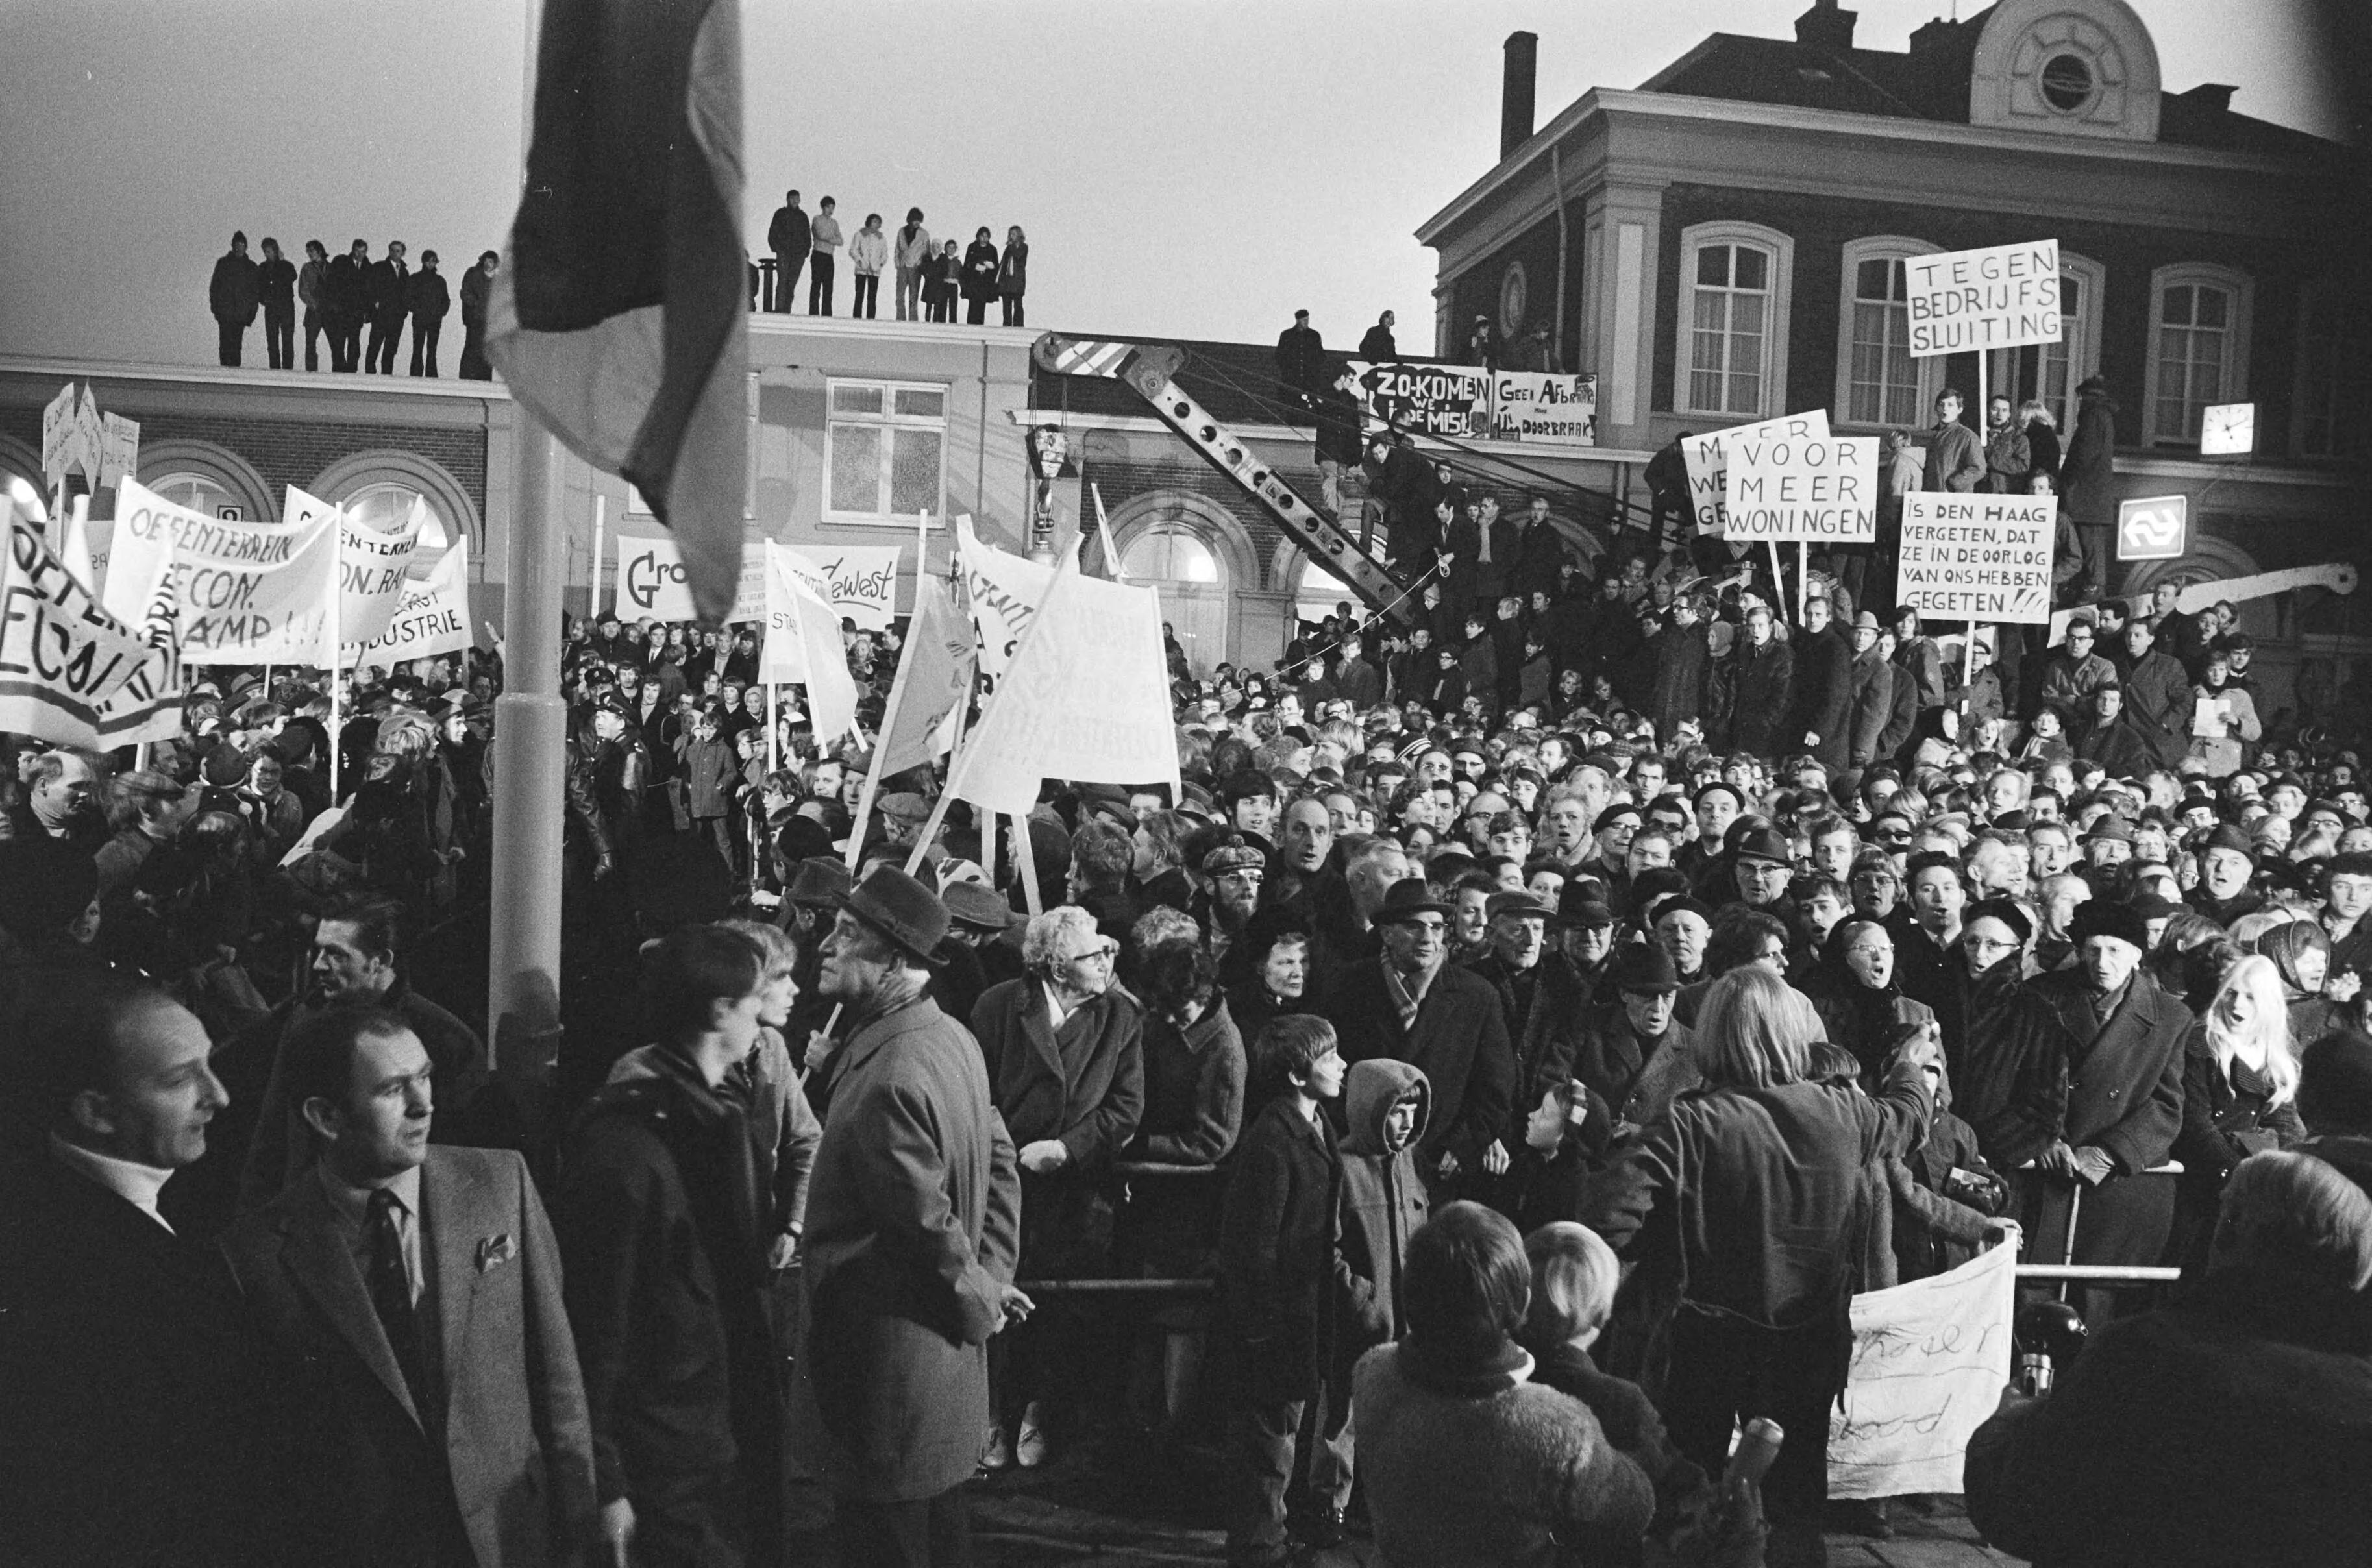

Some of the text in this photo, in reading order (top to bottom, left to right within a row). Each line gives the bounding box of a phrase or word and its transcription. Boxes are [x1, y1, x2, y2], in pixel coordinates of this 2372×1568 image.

[1915, 247, 2054, 287] TEGEN
[1911, 278, 2057, 321] BEDRIJFS
[1914, 311, 2058, 350] SLUITING
[1411, 396, 1435, 410] WE
[1743, 443, 1857, 466] VOOR
[1690, 469, 1727, 494] WE
[1740, 476, 1858, 502] MEER
[1698, 502, 1726, 526] GE
[1725, 508, 1873, 534] WONINGEN
[1936, 504, 1973, 519] DEN
[1984, 506, 2047, 522] HAAG
[1903, 526, 2041, 545] VERGETEN, DAT
[1901, 546, 1923, 561] ZE
[1957, 548, 1979, 563] DE
[1983, 550, 2046, 565] OORLOG
[627, 550, 689, 609] Gro
[1903, 568, 2049, 587] VAN ONS HEBBEN
